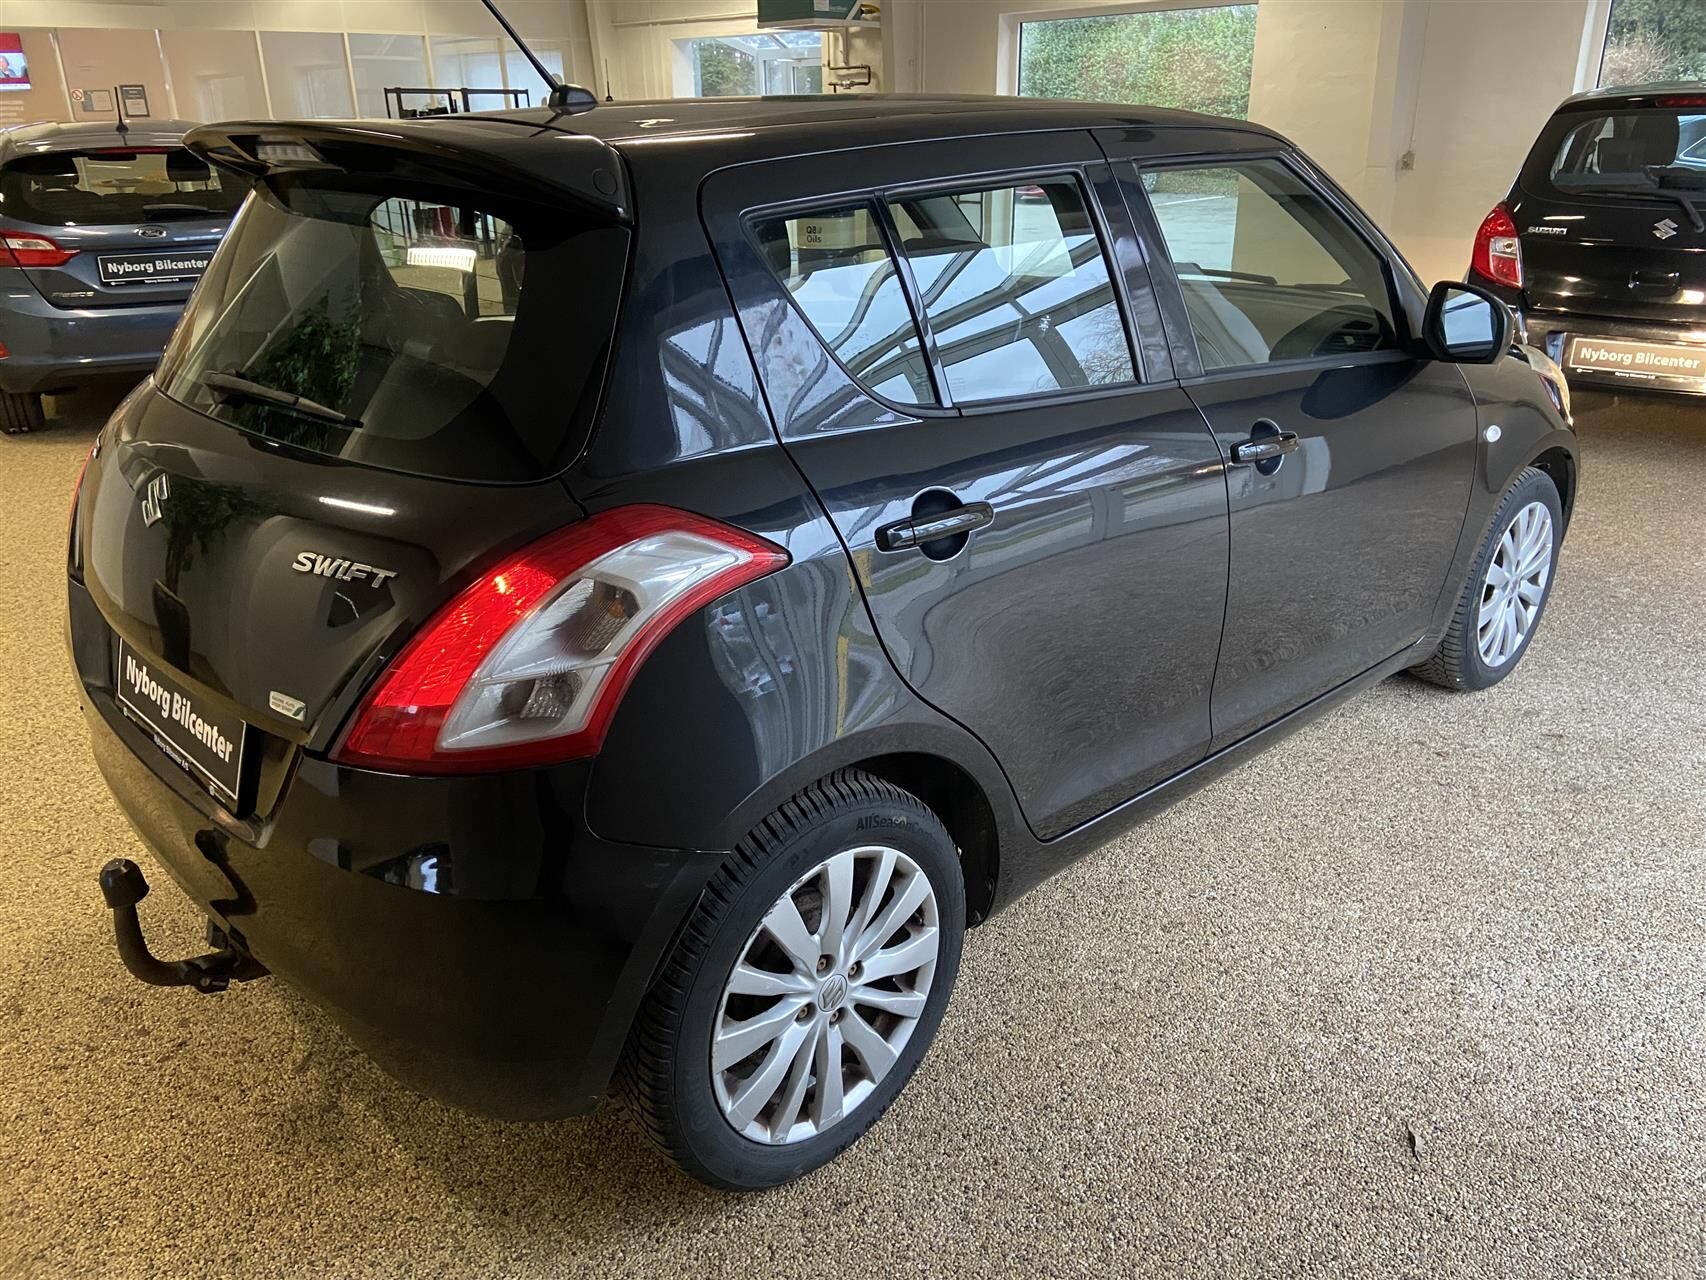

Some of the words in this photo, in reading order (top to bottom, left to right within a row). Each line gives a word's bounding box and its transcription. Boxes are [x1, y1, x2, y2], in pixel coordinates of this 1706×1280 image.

[806, 235, 822, 243] Oils
[107, 261, 154, 275] Nyborg
[155, 259, 209, 271] Bilcenter
[1580, 347, 1633, 366] Nyborg
[1634, 351, 1701, 369] Bilcenter
[292, 551, 398, 588] SWIFT
[126, 655, 171, 719] Nyborg
[171, 692, 233, 763] Bilcenter
